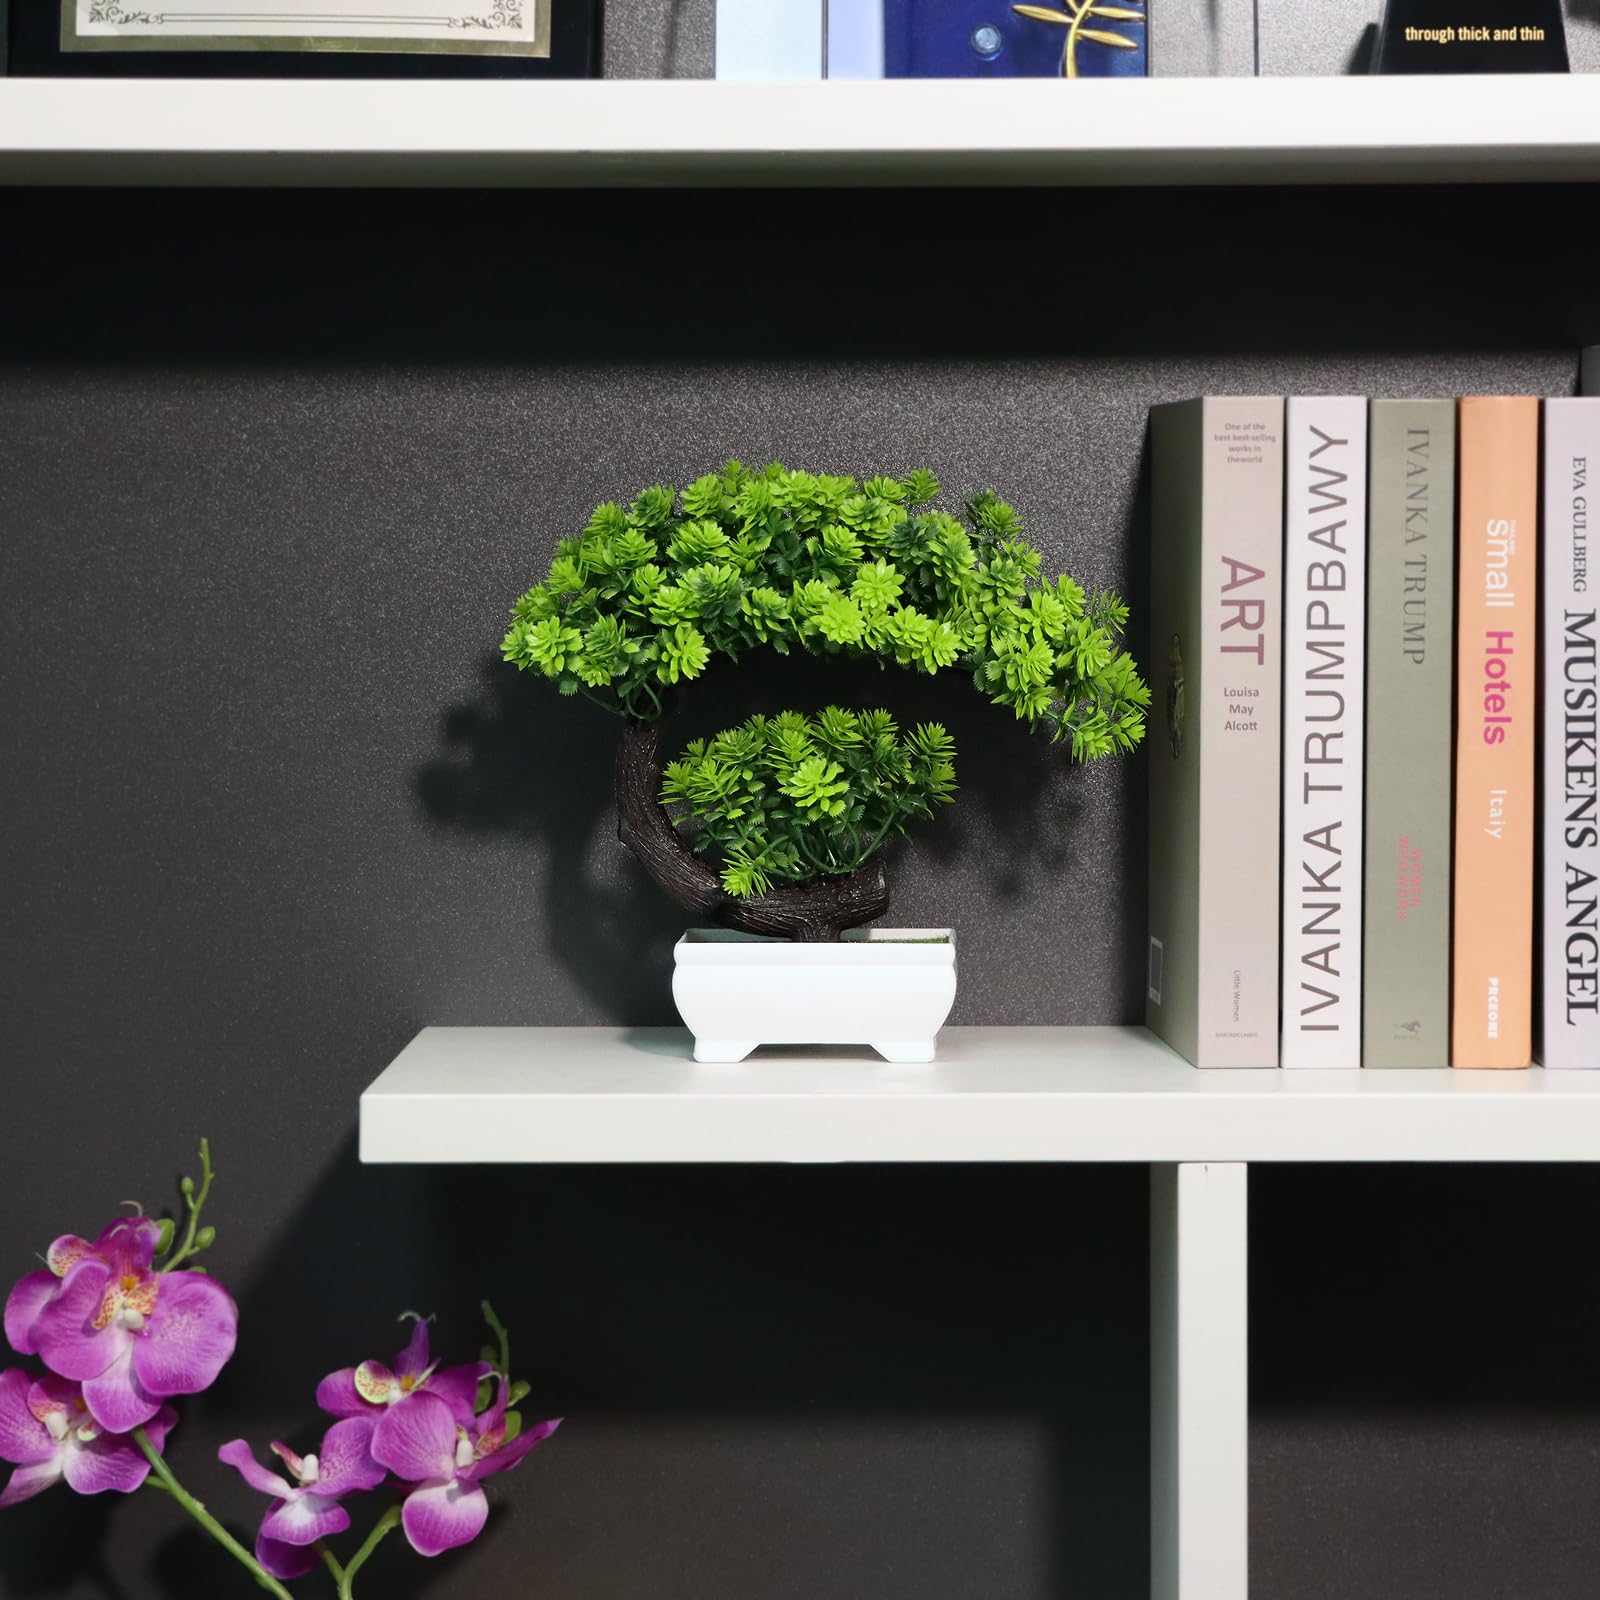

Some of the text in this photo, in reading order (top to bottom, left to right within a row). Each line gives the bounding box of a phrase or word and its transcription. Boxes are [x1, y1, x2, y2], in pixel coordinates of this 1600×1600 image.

[1405, 26, 1545, 43] through thick and thin
[1224, 422, 1266, 432] One of the
[1213, 433, 1231, 442] best
[1228, 444, 1253, 453] works
[1402, 428, 1431, 666] IVANKA TRUMP
[1220, 555, 1266, 666] ART
[1483, 518, 1515, 745] small Hotels
[1223, 686, 1260, 698] Louisa
[1229, 703, 1254, 716] May
[1224, 720, 1258, 732] Alcott
[1300, 424, 1349, 1032] IVANKA TRUMPBAWY
[1563, 456, 1599, 1026] EVA GULLBERG MUSIKENS ANGEL
[1232, 990, 1241, 1022] Women
